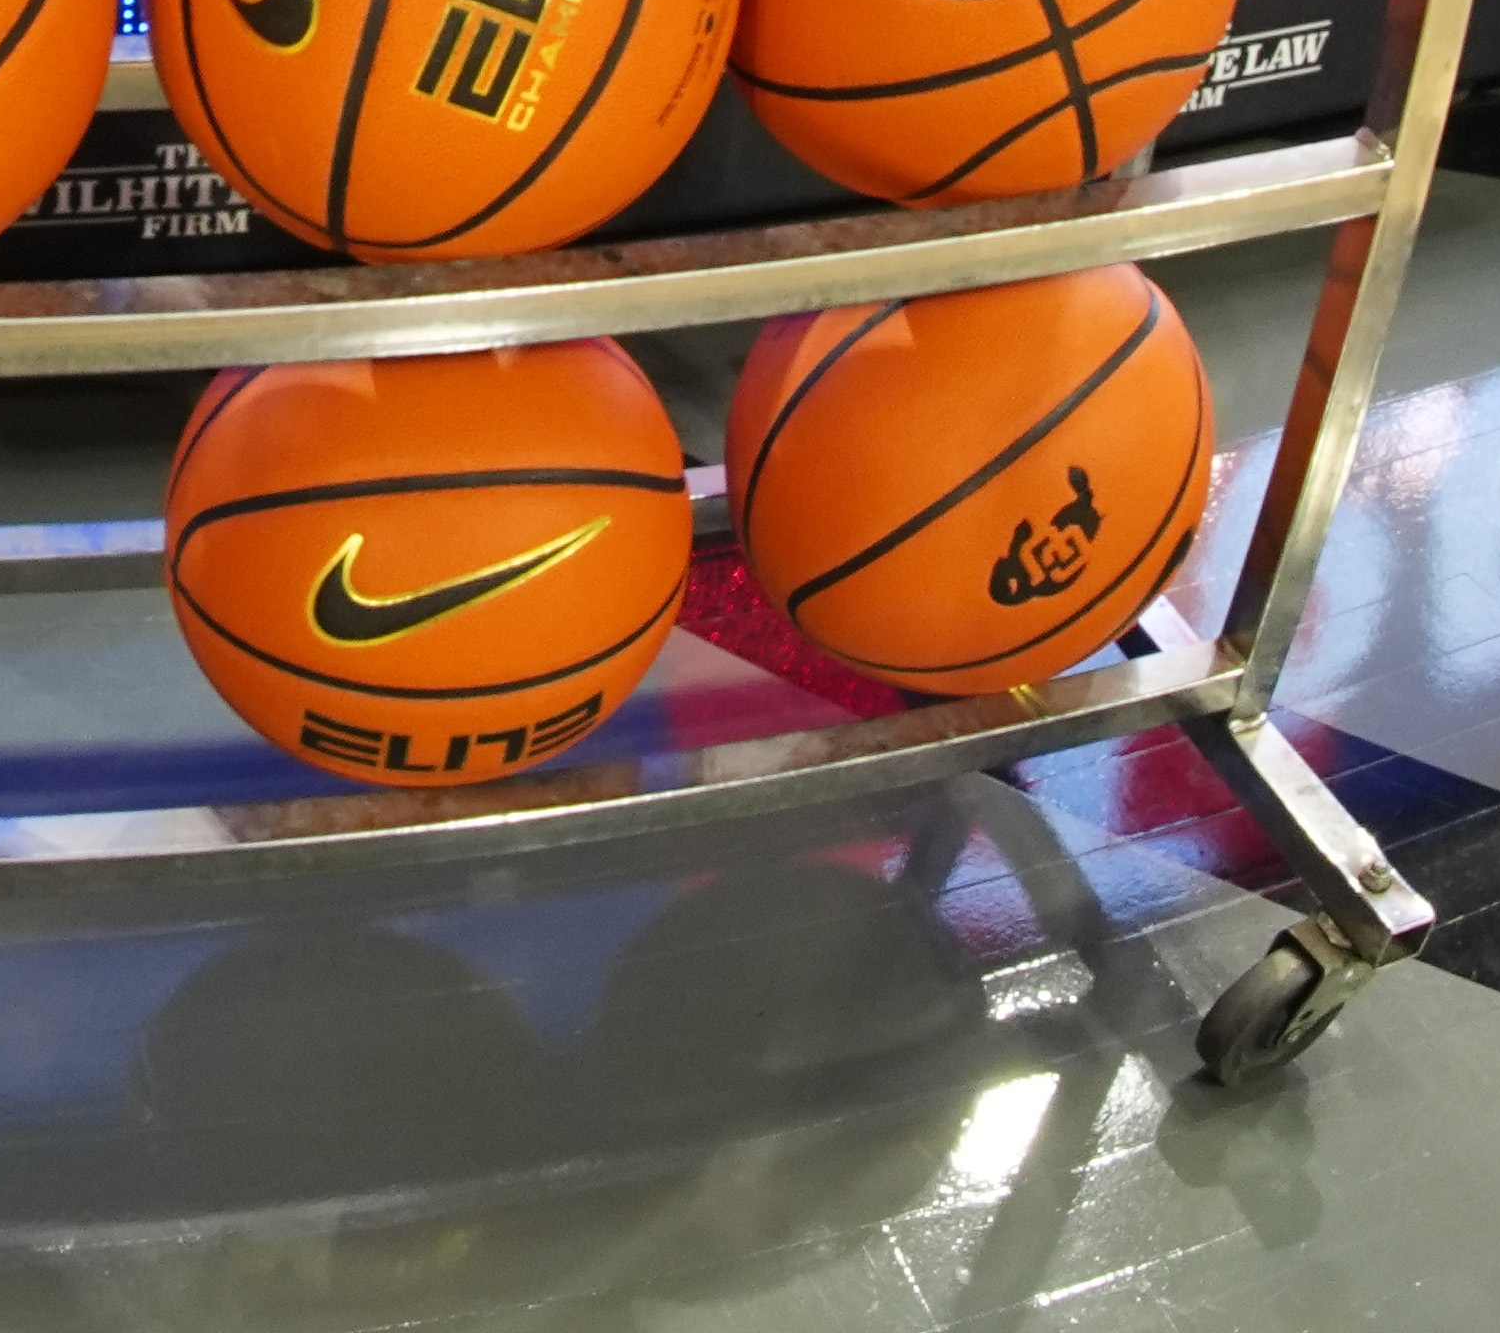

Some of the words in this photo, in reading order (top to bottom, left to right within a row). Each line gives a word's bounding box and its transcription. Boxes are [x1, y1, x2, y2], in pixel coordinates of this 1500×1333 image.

[1242, 30, 1331, 77] LAW
[141, 209, 249, 240] FIRM
[300, 690, 604, 772] ELITE
